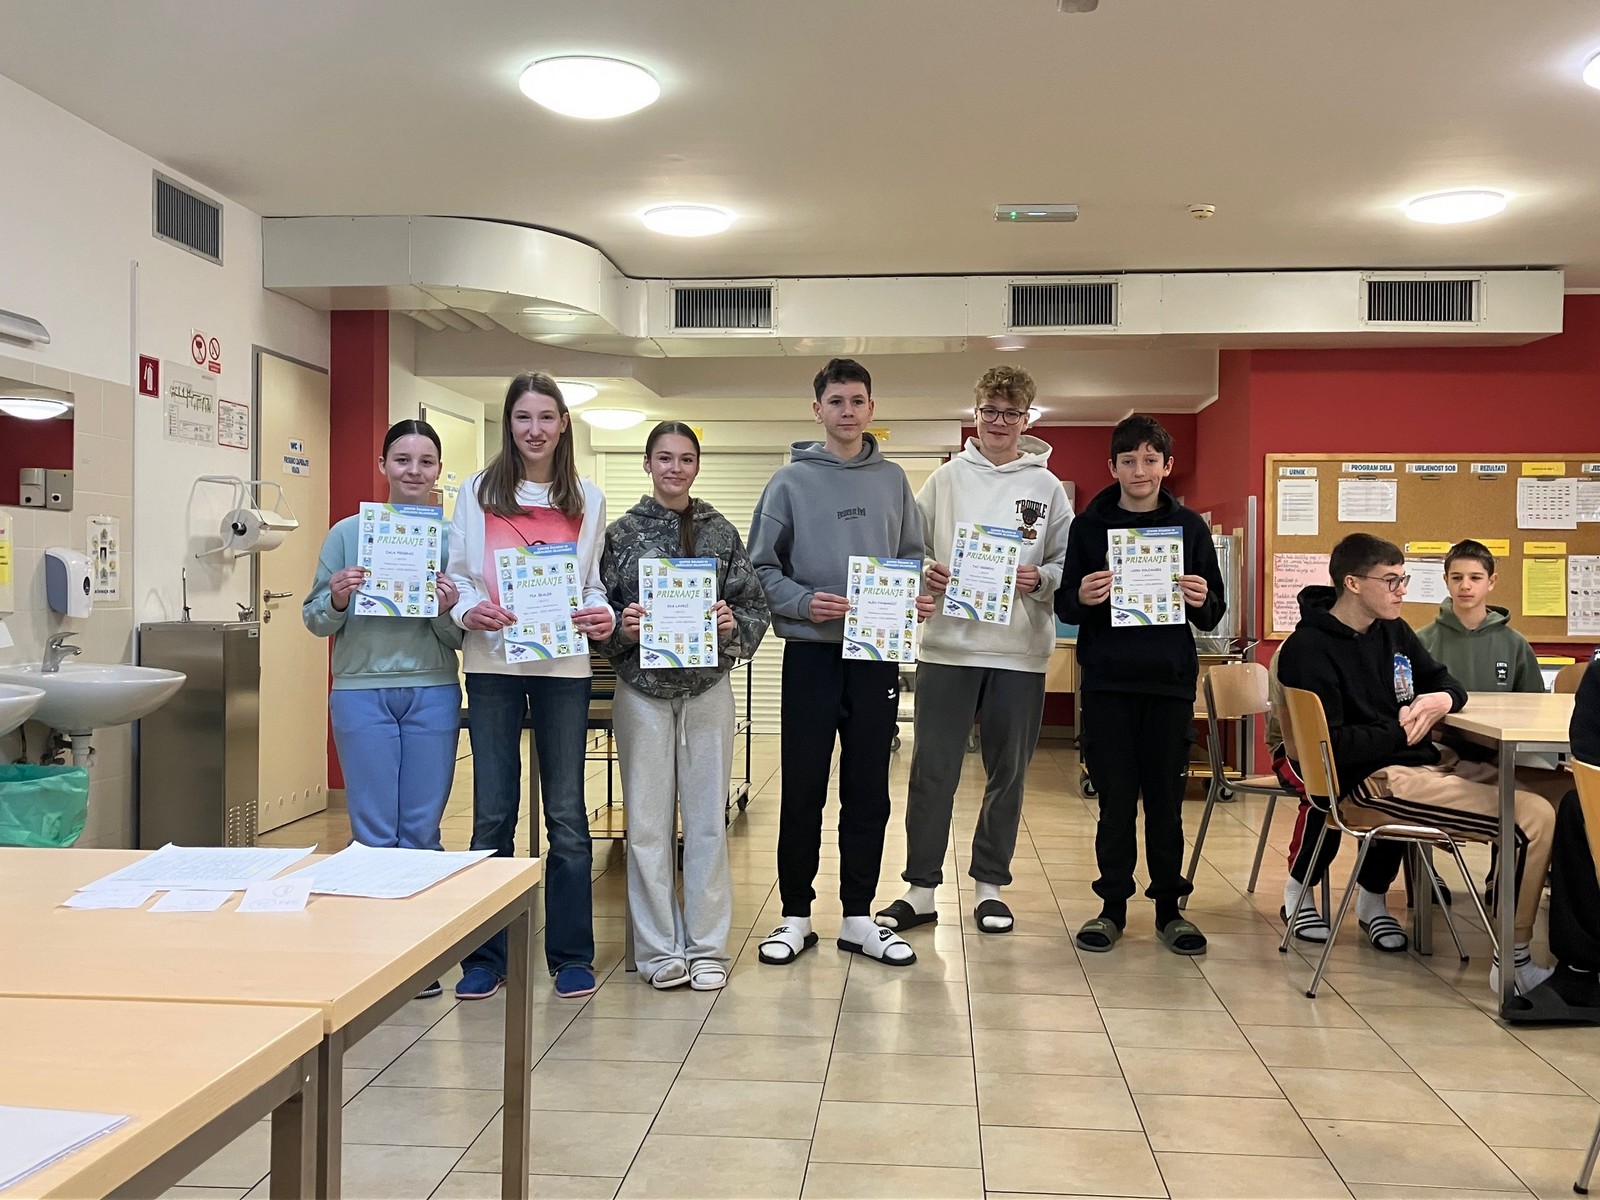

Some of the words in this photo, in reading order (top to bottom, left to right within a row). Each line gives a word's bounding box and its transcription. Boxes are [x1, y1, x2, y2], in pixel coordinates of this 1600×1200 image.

[1288, 468, 1306, 476] URNIK
[377, 535, 424, 547] PRIZNANJE
[966, 551, 1005, 564] PRIZNANJE
[1125, 555, 1168, 564] PRIZNANJE
[516, 576, 563, 589] PRIZNANJE
[656, 589, 700, 599] PRIZNANJE
[863, 587, 905, 598] PRIZNANJE
